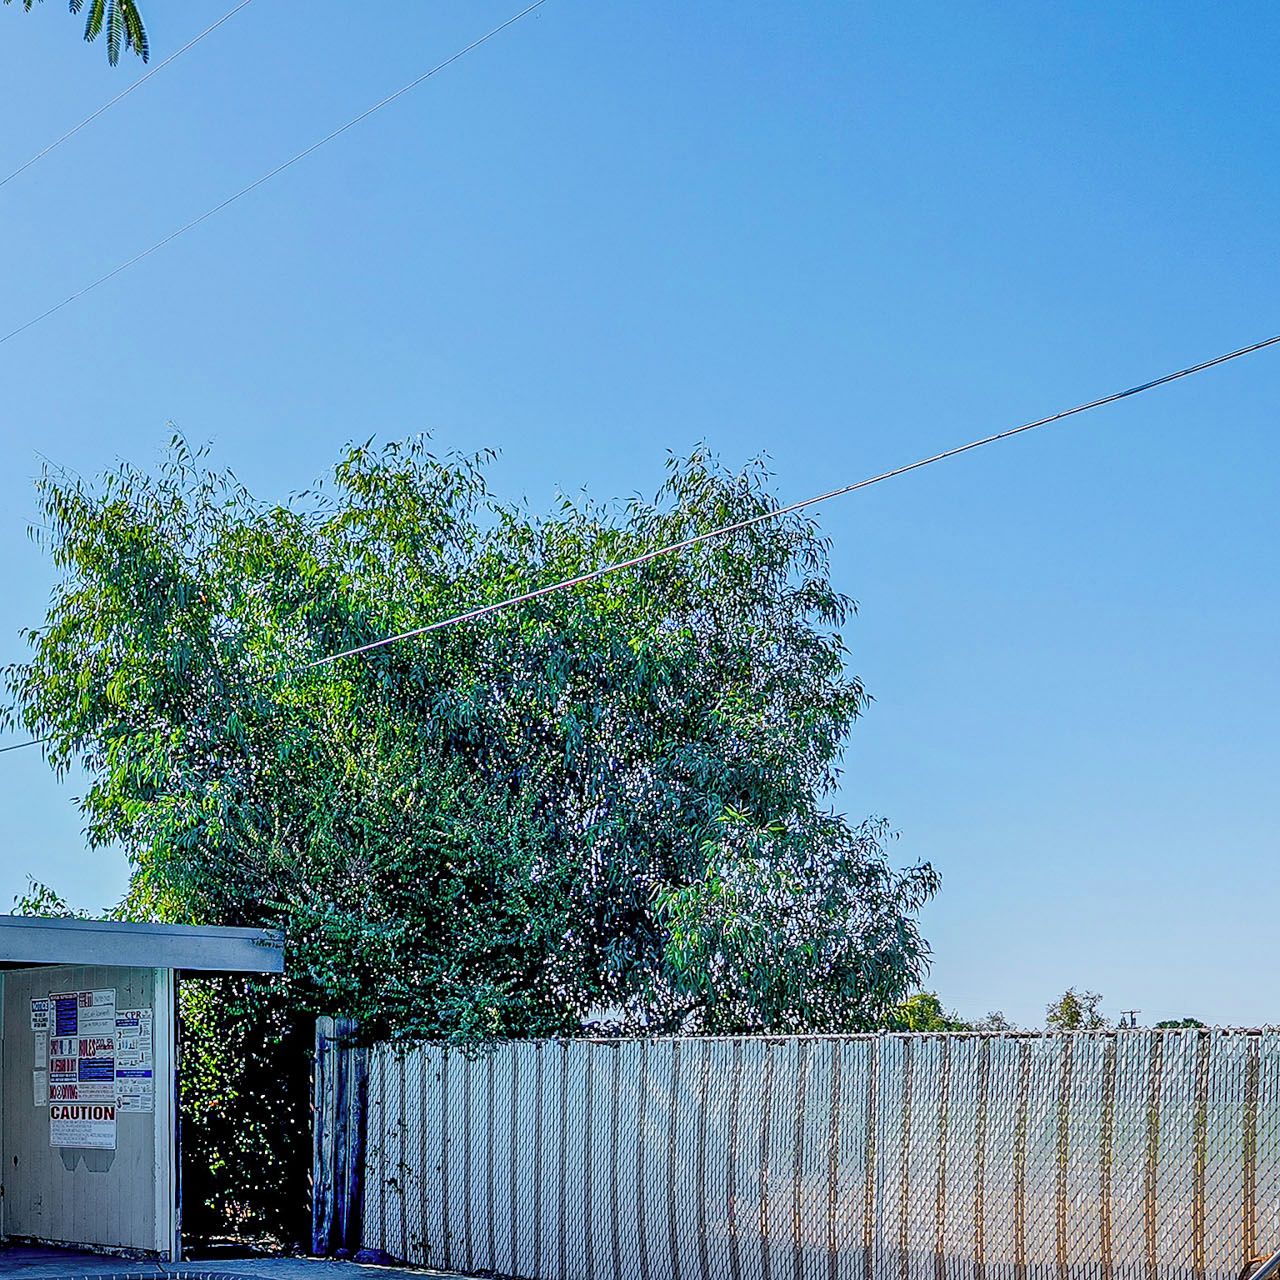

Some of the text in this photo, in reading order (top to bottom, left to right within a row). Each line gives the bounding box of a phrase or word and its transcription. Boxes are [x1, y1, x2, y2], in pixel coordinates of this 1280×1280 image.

[32, 1001, 48, 1011] NOTICE
[125, 1011, 141, 1019] CPR
[79, 1039, 96, 1057] RULES
[62, 1084, 78, 1100] DIVING
[50, 1105, 115, 1120] CAUTION
